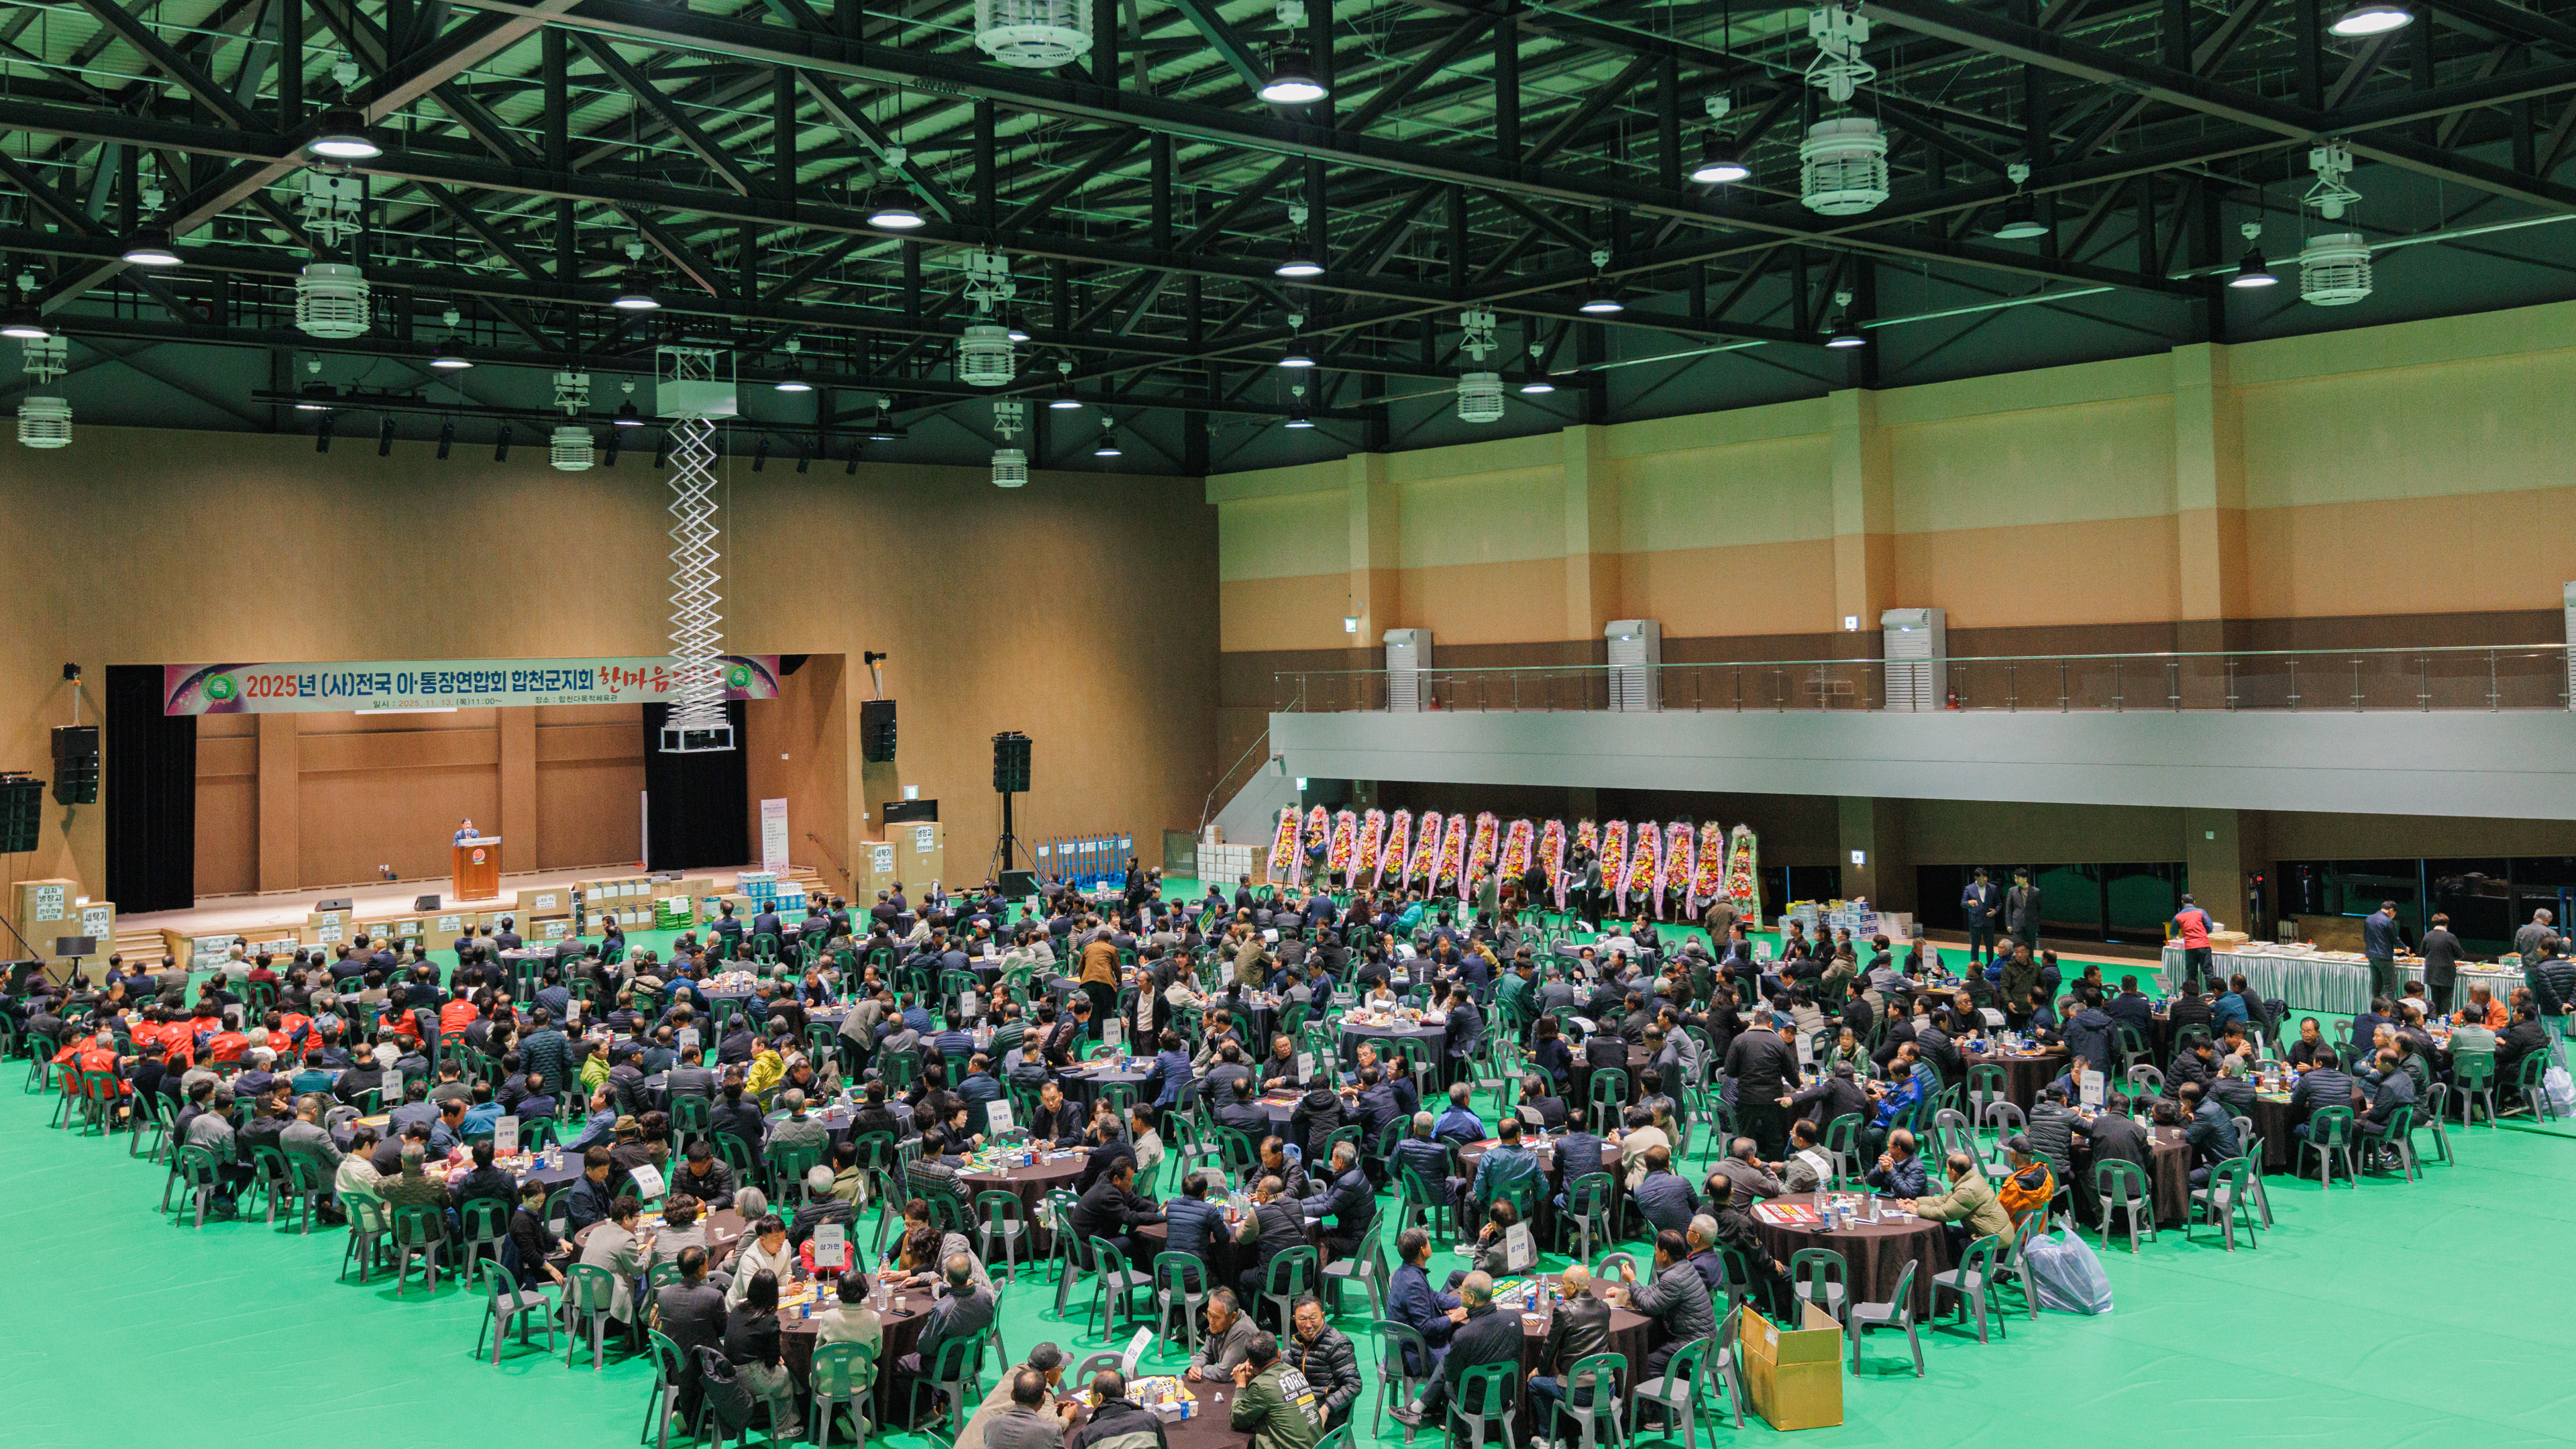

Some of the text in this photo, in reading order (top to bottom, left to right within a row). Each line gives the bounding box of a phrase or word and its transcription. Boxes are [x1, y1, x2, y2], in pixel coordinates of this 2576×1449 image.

[734, 669, 746, 683] 축
[246, 674, 316, 698] 2025년
[321, 672, 392, 697] (사)전국
[511, 668, 594, 692] 합천군지회
[598, 665, 720, 694] 한마음
[212, 680, 227, 694] 축
[372, 700, 389, 708] 일시
[535, 696, 550, 704] 장소
[558, 694, 618, 704] 합천다목적체육관
[917, 828, 932, 838] 냉장고
[876, 849, 892, 857] 세탁기
[39, 894, 62, 902] 냉장고
[85, 912, 107, 922] 세탁기
[642, 1176, 659, 1184] 적중면
[1511, 1242, 1525, 1253] 삼가면
